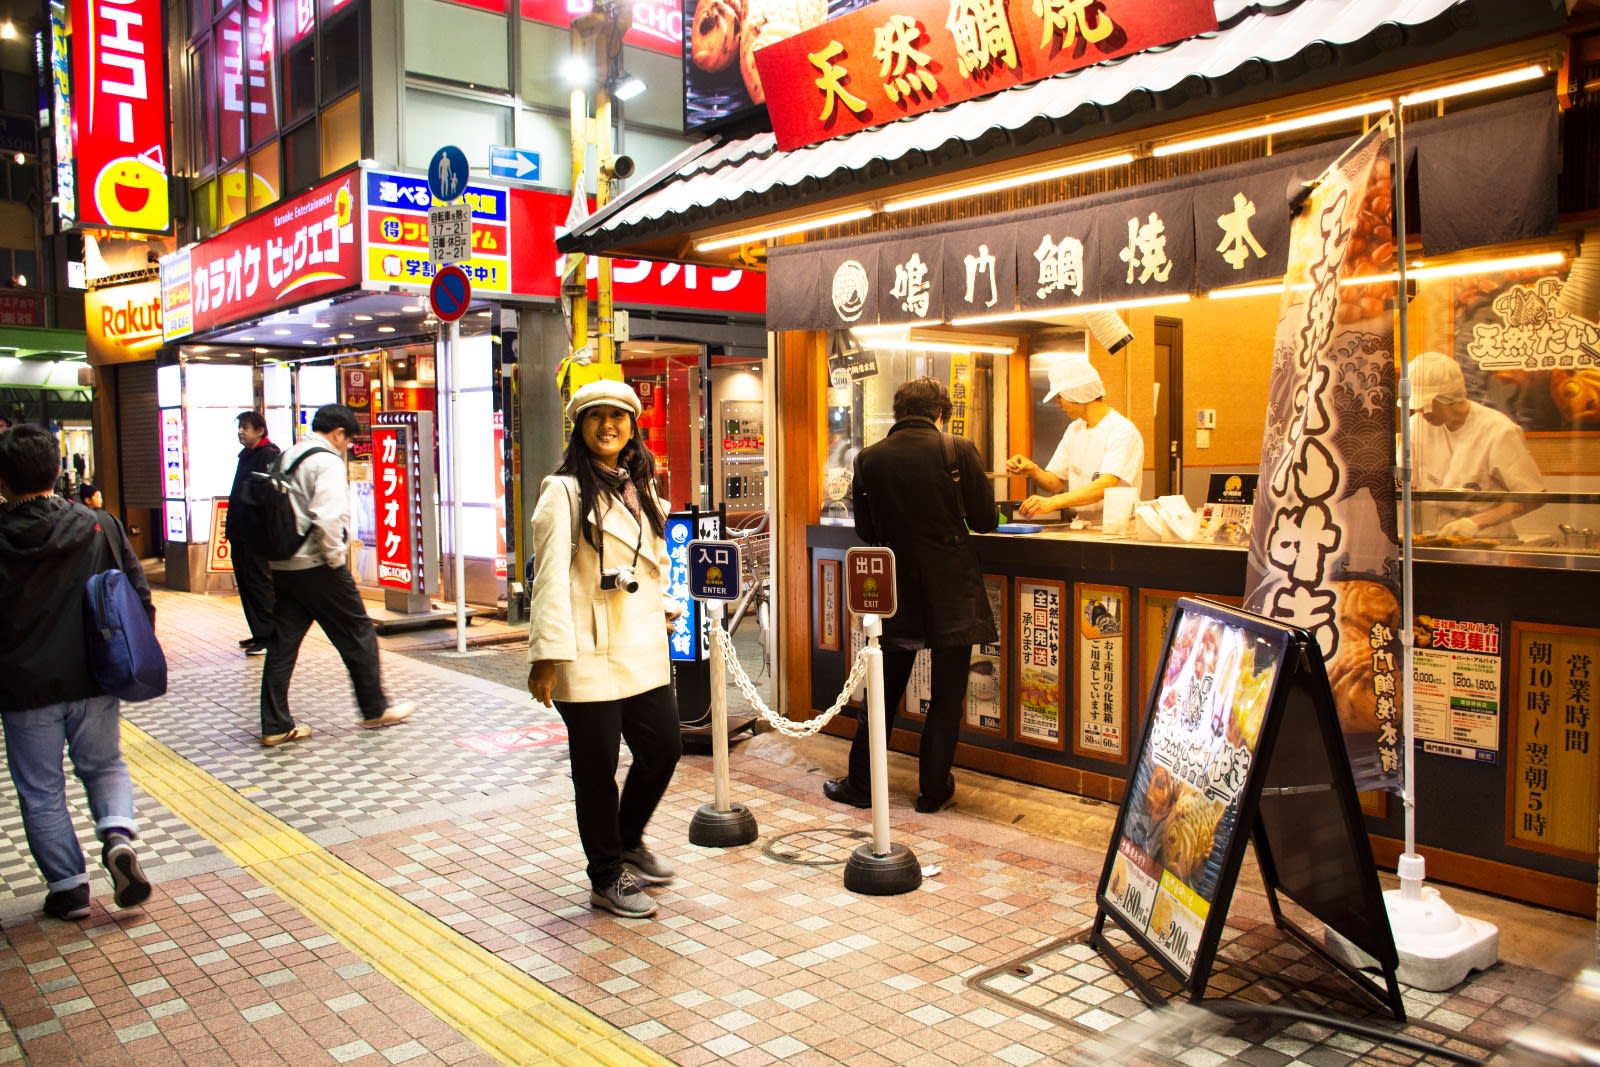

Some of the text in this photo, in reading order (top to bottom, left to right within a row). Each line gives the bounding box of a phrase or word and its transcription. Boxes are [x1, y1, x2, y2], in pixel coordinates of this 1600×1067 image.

[100, 0, 148, 144] エコー
[274, 192, 333, 228] Karaoke Entertainment
[403, 222, 497, 250] フリイム
[431, 209, 468, 223] 自転車を除く
[194, 213, 354, 314] カラオケ ビッグエコー
[382, 435, 402, 558] カラオケ
[699, 549, 729, 565] 入口
[856, 556, 884, 575] 出口
[702, 587, 727, 595] ENTER
[863, 600, 879, 608] EXIT
[1022, 612, 1033, 664] 承ります
[1033, 588, 1048, 667] 全国発送
[1048, 593, 1059, 666] 天然たいやき
[1433, 629, 1498, 653] 大募集!!
[1090, 639, 1101, 721] ご用意しています
[1103, 640, 1114, 724] お土産用の化粧箱
[1565, 653, 1593, 755] 営業時間
